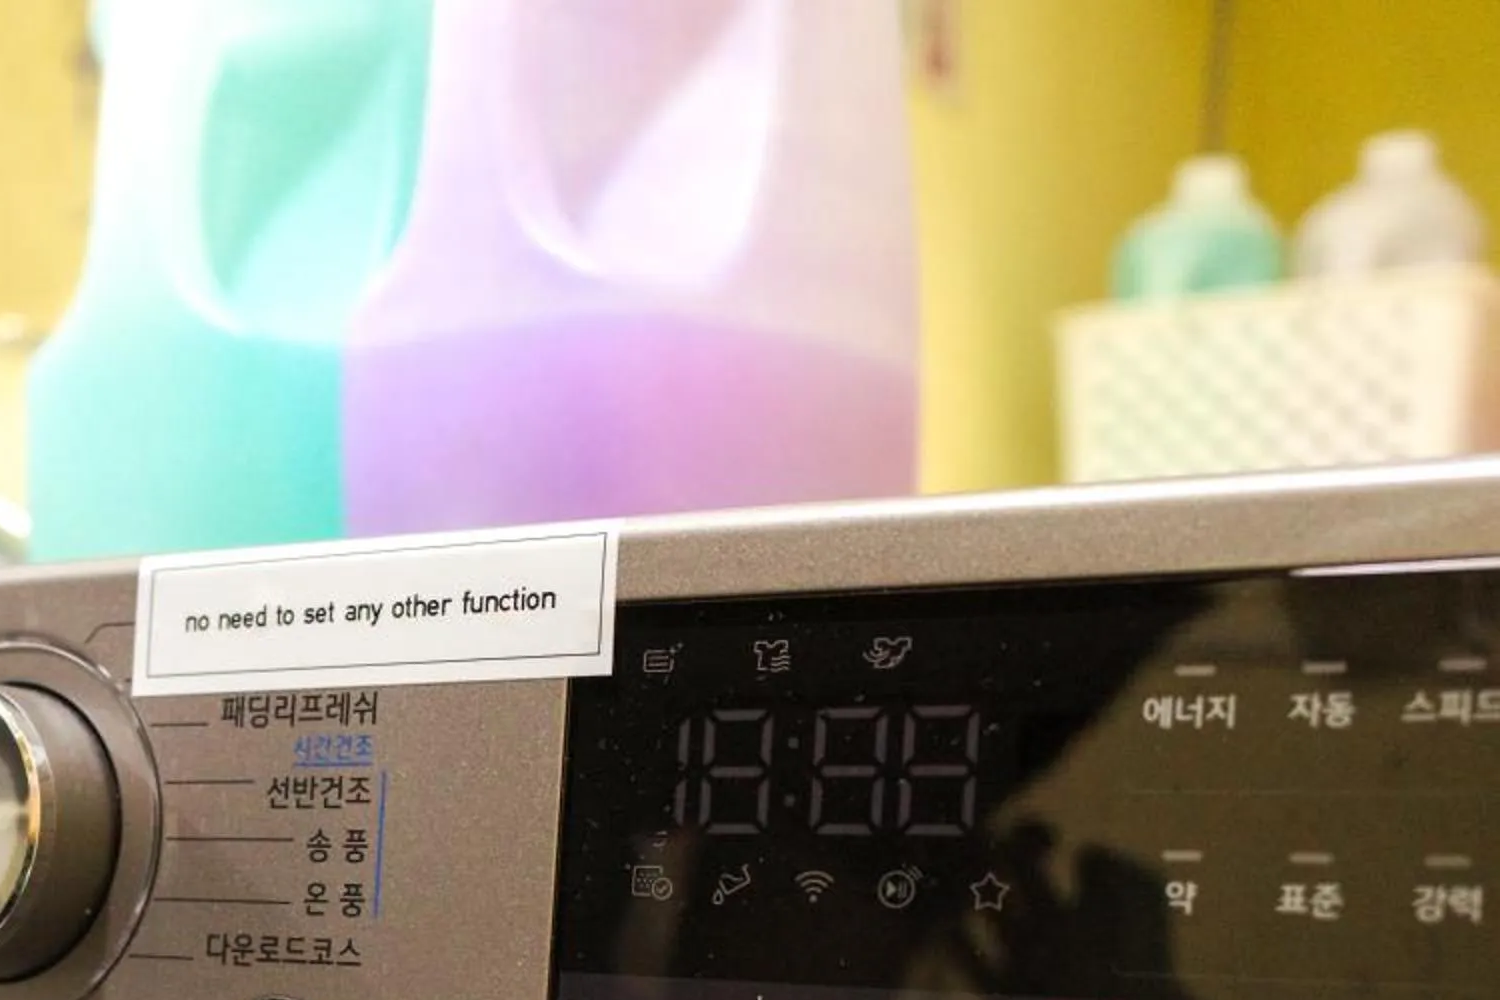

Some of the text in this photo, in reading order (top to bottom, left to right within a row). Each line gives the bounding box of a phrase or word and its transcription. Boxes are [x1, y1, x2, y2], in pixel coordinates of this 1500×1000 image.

[185, 586, 557, 633] no need to set any other function
[220, 691, 379, 730] 패딩리프레쉬
[1142, 693, 1237, 730] 에너지
[1288, 691, 1356, 729] 자동
[267, 775, 371, 810] 선반건조
[1164, 881, 1198, 915] 약
[1276, 883, 1344, 920] 표준
[1411, 886, 1485, 923] 강력
[205, 932, 362, 968] 다운로드코스
